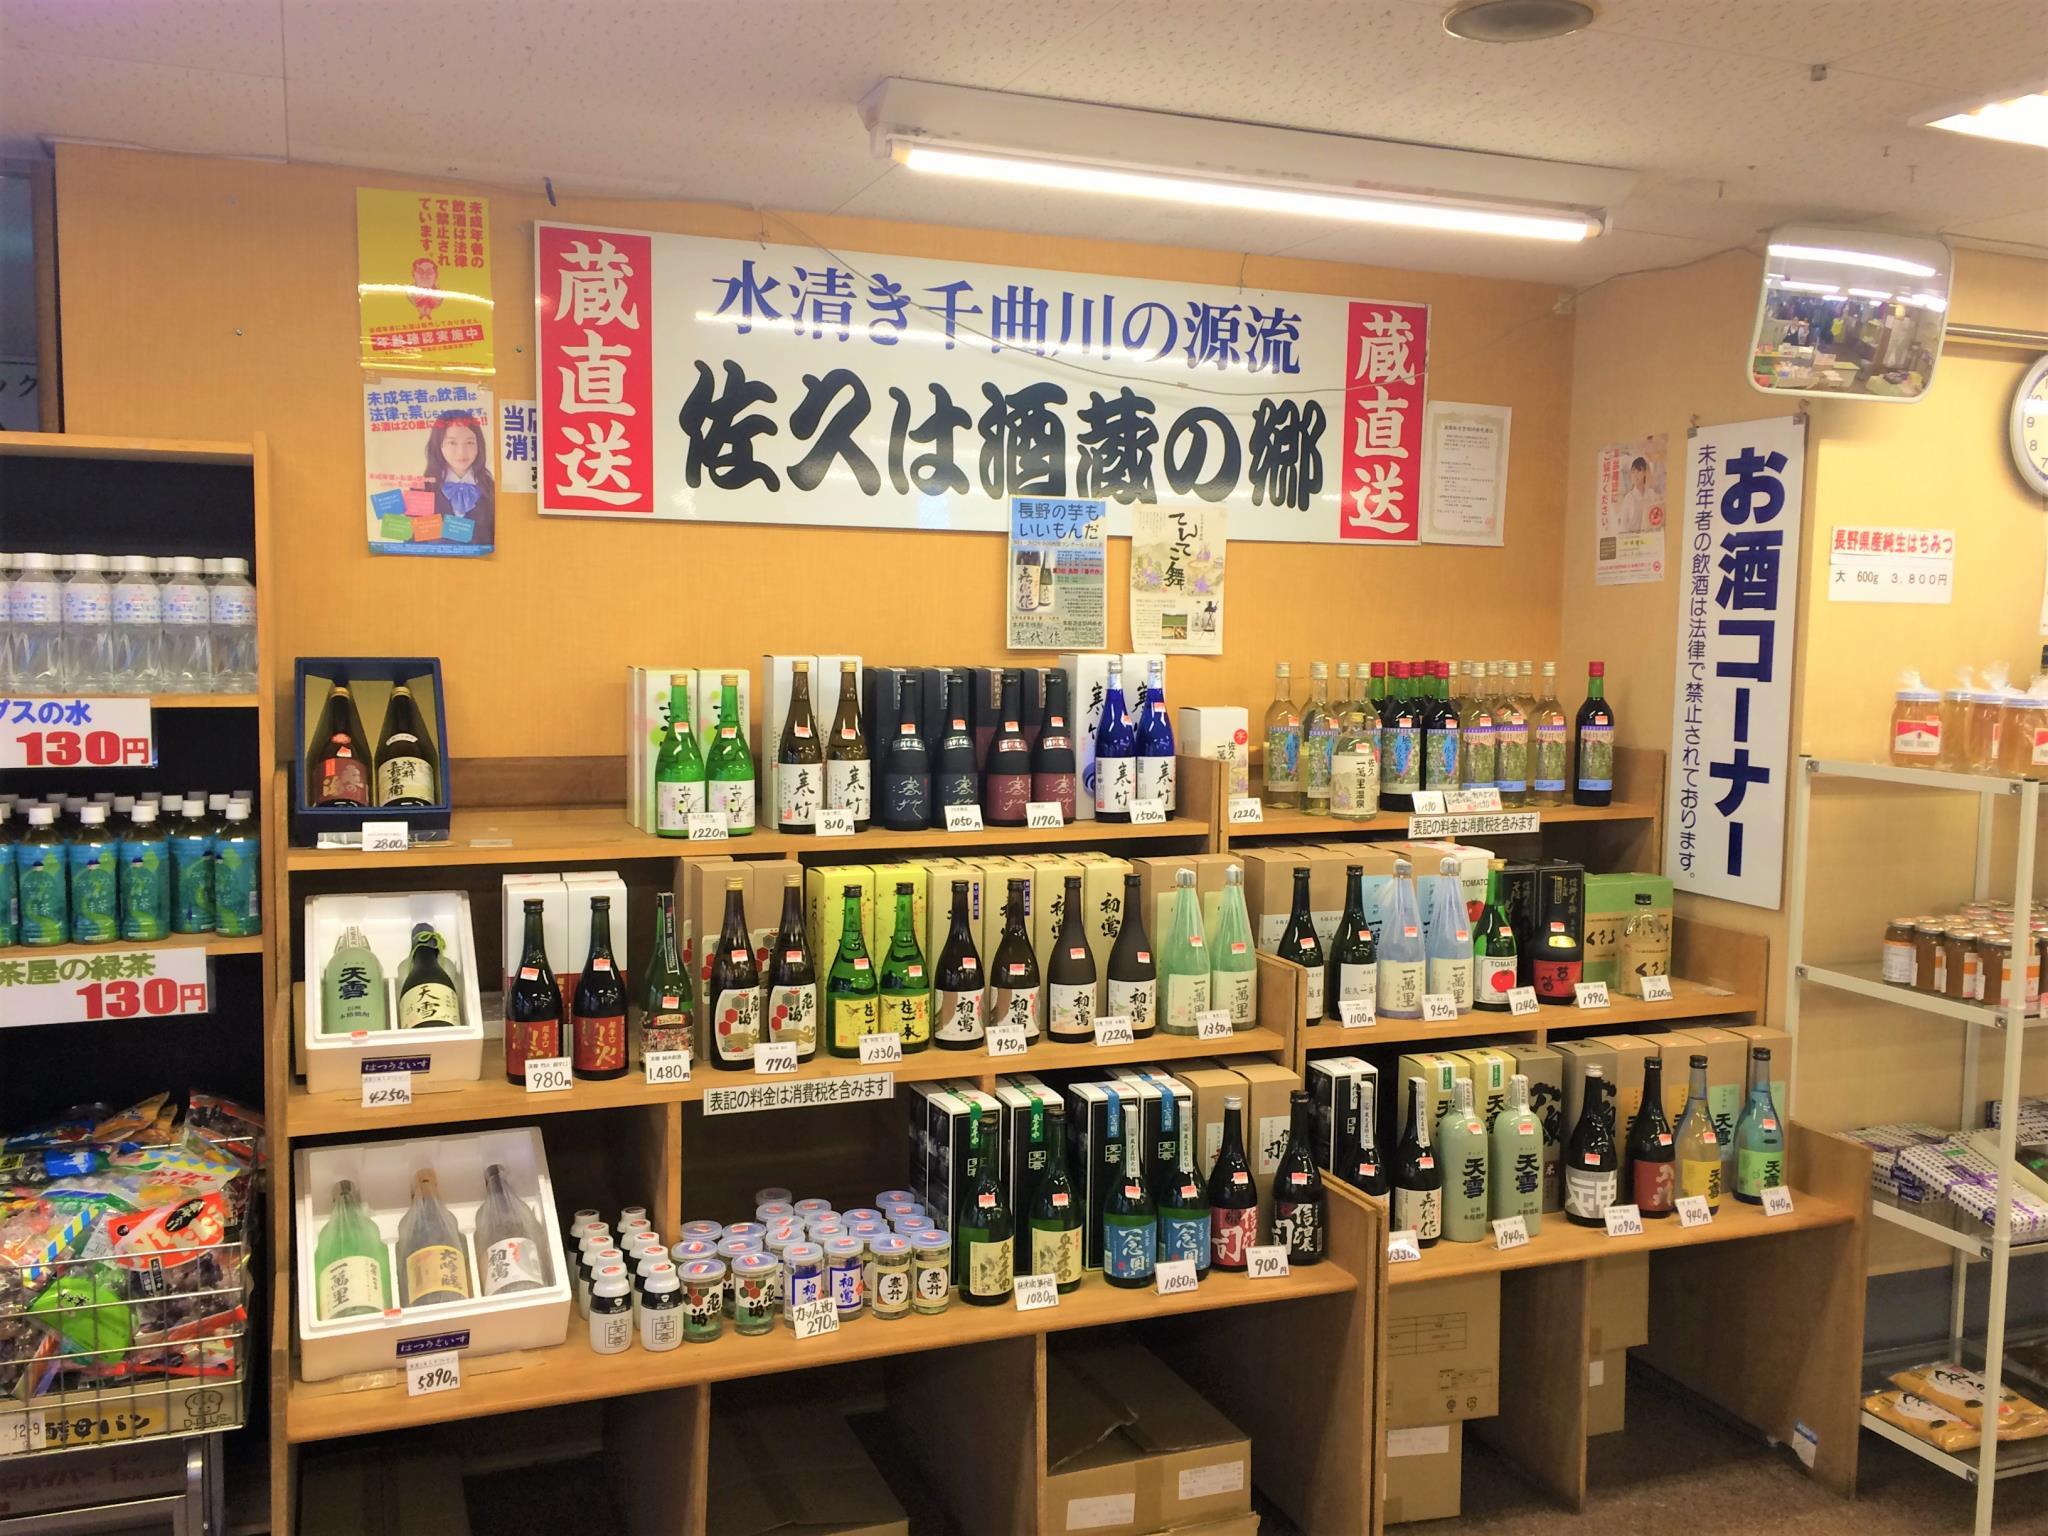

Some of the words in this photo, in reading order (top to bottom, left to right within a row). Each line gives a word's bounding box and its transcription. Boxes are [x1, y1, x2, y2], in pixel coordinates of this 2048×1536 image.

[418, 198, 434, 257] ています。
[436, 199, 451, 266] で禁止され
[452, 199, 467, 268] 飲酒は法律
[469, 202, 484, 268] 未成年者の
[711, 259, 1302, 375] 水清き千曲川の源流
[376, 329, 479, 347] 年齢確認実施中
[553, 238, 642, 505] 蔵直送
[367, 387, 477, 406] 未成年者の飲酒は
[679, 359, 1327, 512] 佐久は酒蔵の郷
[1349, 310, 1416, 533] 蔵直送
[2026, 416, 2035, 428] 9
[2029, 440, 2038, 451] 8
[1019, 502, 1099, 521] 長野の芋も
[1020, 523, 1098, 539] いいもんだ
[1834, 529, 1952, 553] 長野県産純生はちみつ
[1835, 570, 1846, 583] 大
[1857, 570, 1879, 584] 600g
[1678, 444, 1717, 878] 未成年者の飲酒は法律で禁止されております。
[1709, 446, 1788, 877] お酒コーナー
[16, 731, 149, 766] 130円
[793, 769, 815, 820] 寒竹
[1113, 762, 1131, 806] 寒竹
[824, 820, 853, 832] 810円
[950, 817, 981, 829] 1050円
[1031, 815, 1062, 827] 1170円
[1135, 809, 1164, 821] 1500円
[1413, 815, 1535, 835] 表記の料金は消費税を含みます
[692, 827, 727, 838] 1220円
[0, 953, 156, 987] 茶屋の緑茶
[338, 966, 371, 1000] 天雪
[76, 978, 206, 1020] 130円
[416, 985, 440, 1019] 天雪
[1130, 988, 1147, 1022] 初鶯
[1235, 978, 1249, 1019] 一萬里
[1402, 969, 1416, 1008] 一萬里
[901, 999, 920, 1038] 生一本
[956, 997, 974, 1032] 初鶯
[1073, 991, 1090, 1026] 初鶯
[1350, 1012, 1373, 1023] 1100円
[1430, 1004, 1455, 1017] 950円
[996, 1038, 1024, 1051] 950円
[533, 1071, 572, 1088] 980円
[765, 1057, 797, 1071] 770円
[710, 1076, 888, 1112] 表記の料金は消費税を含みます
[1463, 1158, 1486, 1199] 天雪
[1515, 1153, 1539, 1194] 天雪
[1686, 1208, 1709, 1222] 940円
[1769, 1199, 1792, 1212] 940円
[440, 1249, 462, 1290] 大吟醸
[926, 1270, 942, 1295] 寒竹
[1255, 1258, 1287, 1275] 900円
[887, 1275, 903, 1300] 寒竹
[795, 1300, 833, 1321] カップ酒
[807, 1313, 838, 1335] 270円
